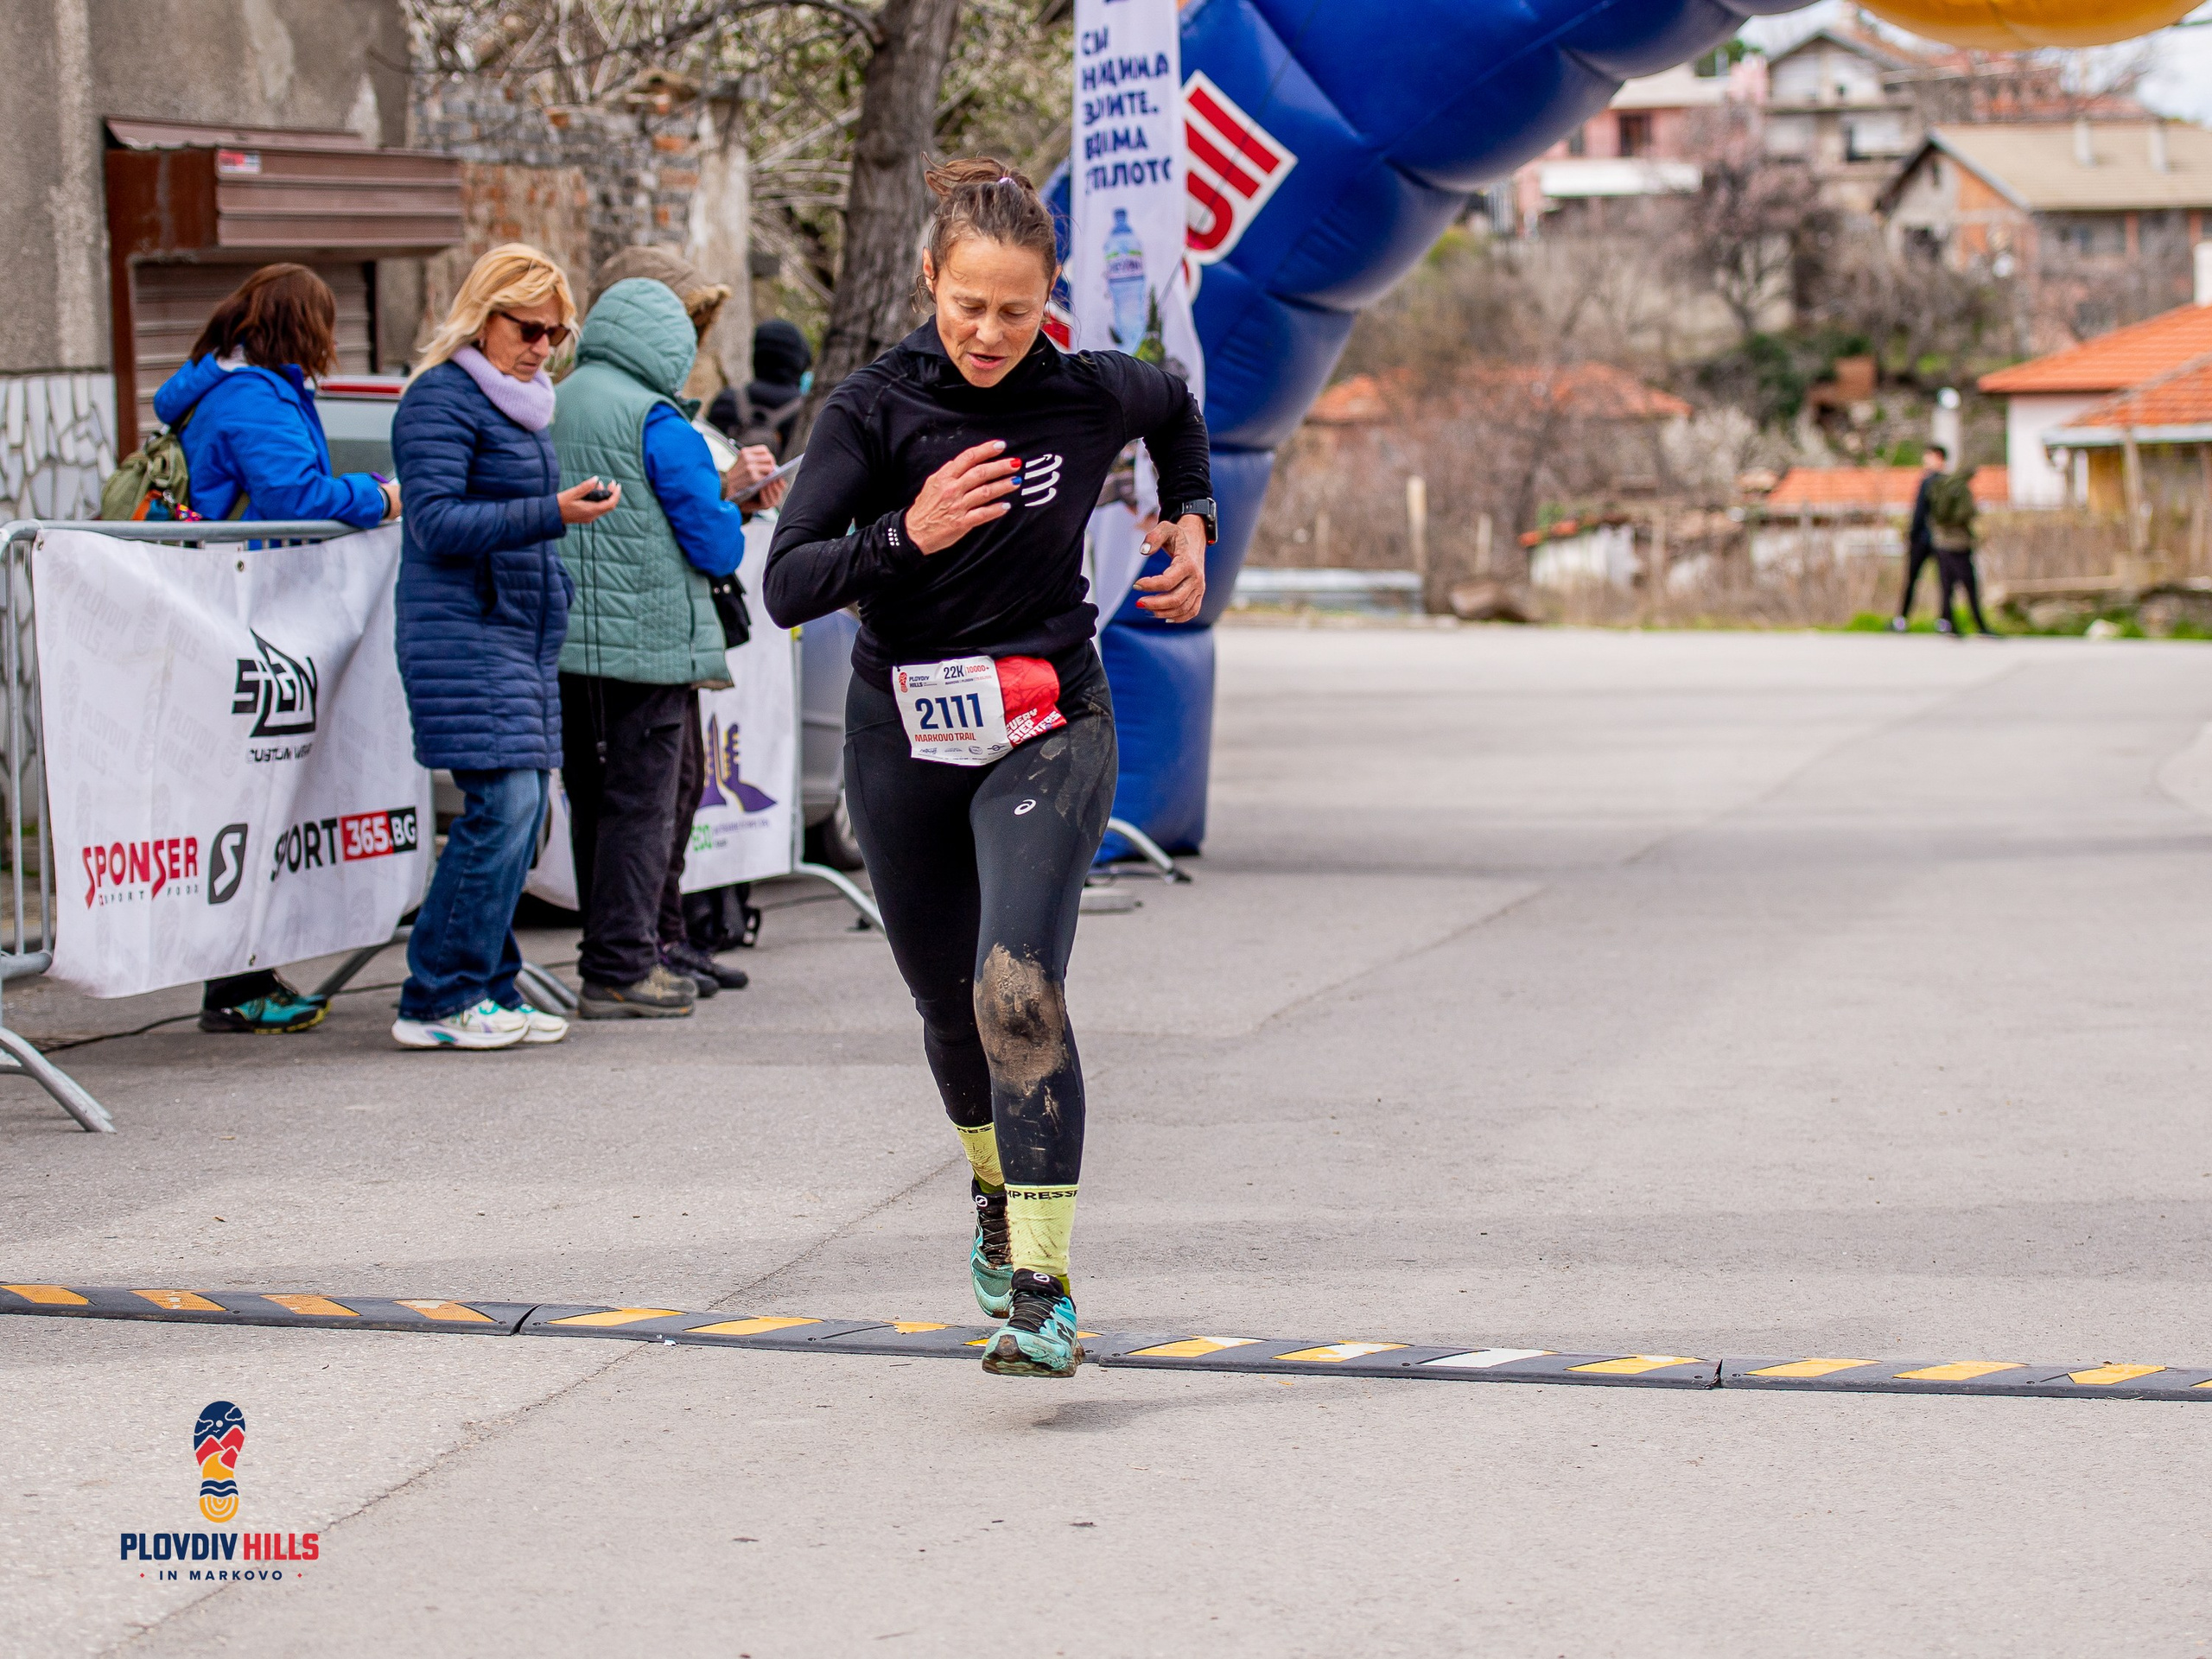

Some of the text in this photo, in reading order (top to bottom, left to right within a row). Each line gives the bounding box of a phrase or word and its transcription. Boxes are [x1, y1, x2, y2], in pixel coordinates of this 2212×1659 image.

[944, 664, 964, 680] 22K
[915, 693, 983, 730] 2111
[914, 732, 976, 742] MARKOVO TRAIL
[1007, 719, 1034, 743] STEP
[82, 836, 198, 910] SPONSER
